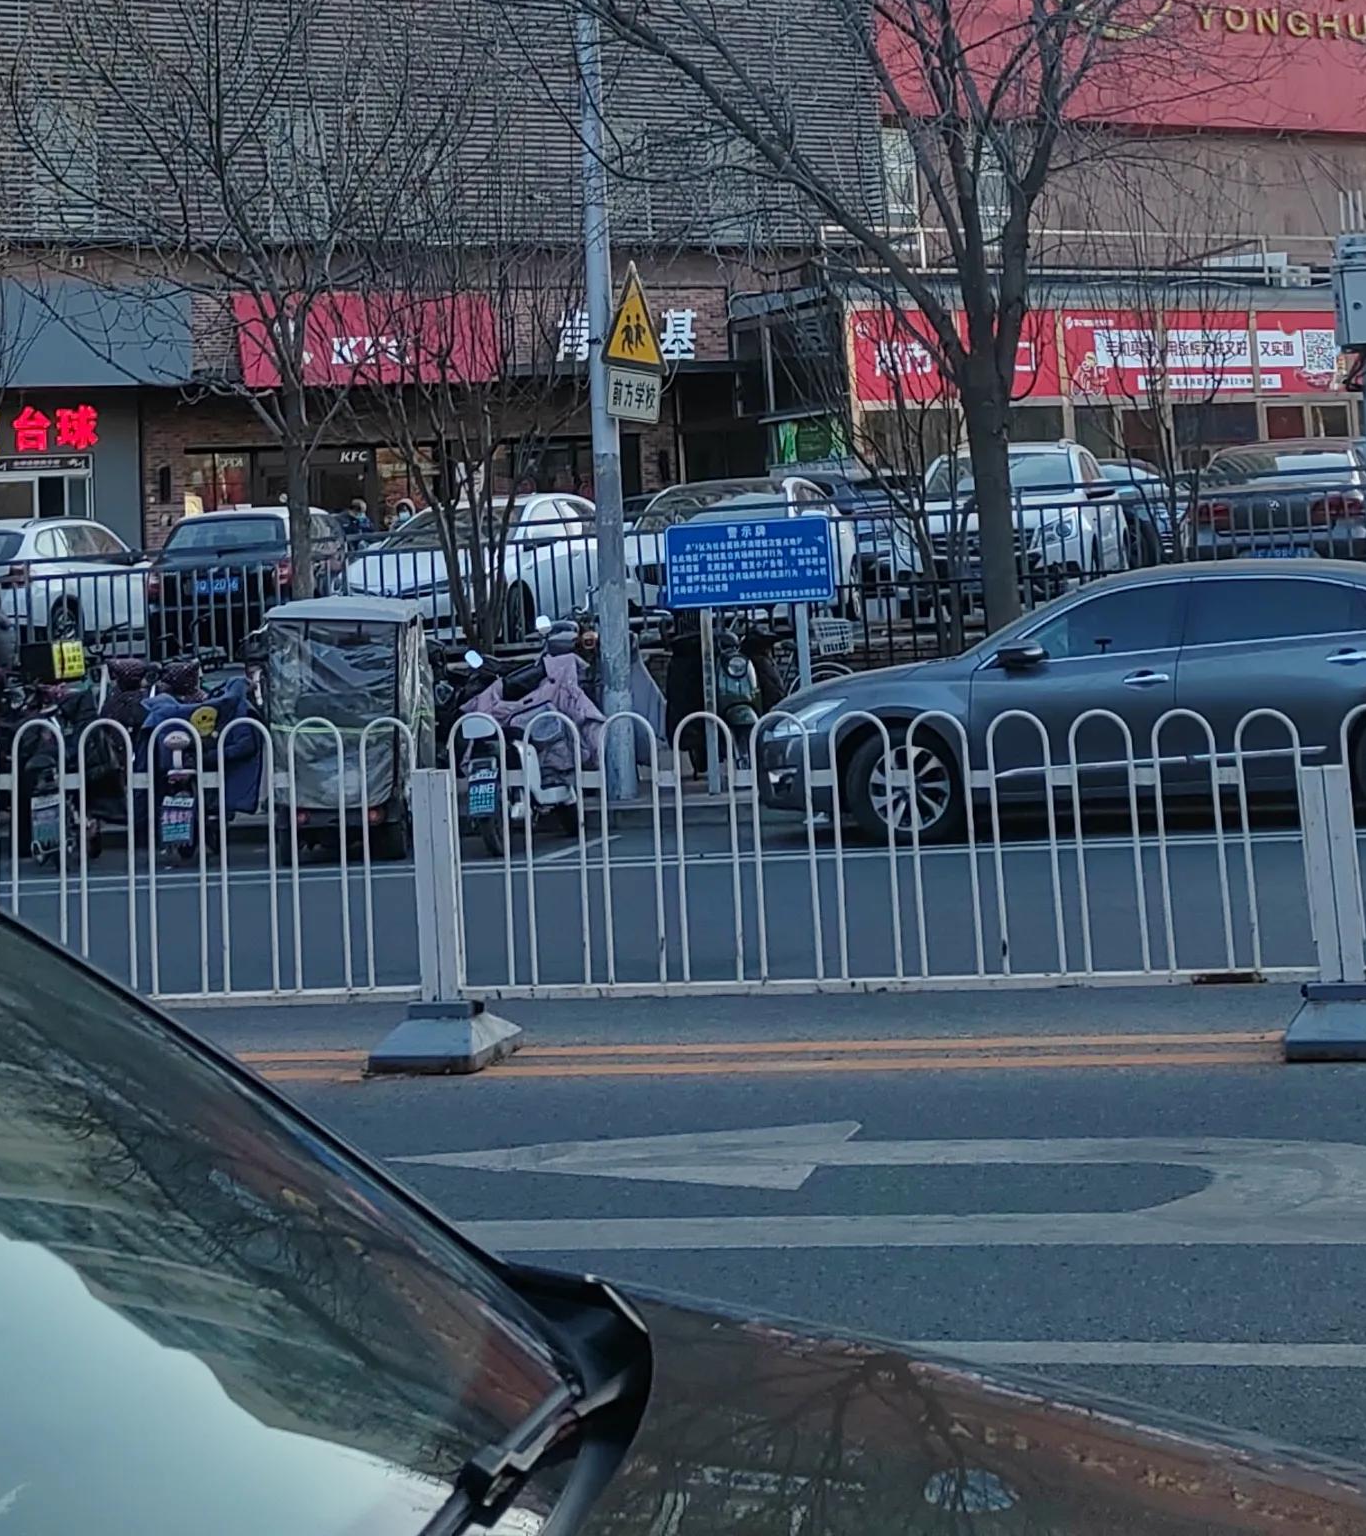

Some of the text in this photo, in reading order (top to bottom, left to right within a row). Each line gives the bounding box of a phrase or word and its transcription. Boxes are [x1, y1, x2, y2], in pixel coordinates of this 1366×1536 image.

[555, 308, 698, 362] 肯基
[612, 378, 657, 411] 前方学校
[339, 450, 369, 463] KFC
[726, 524, 766, 539] 警示牌
